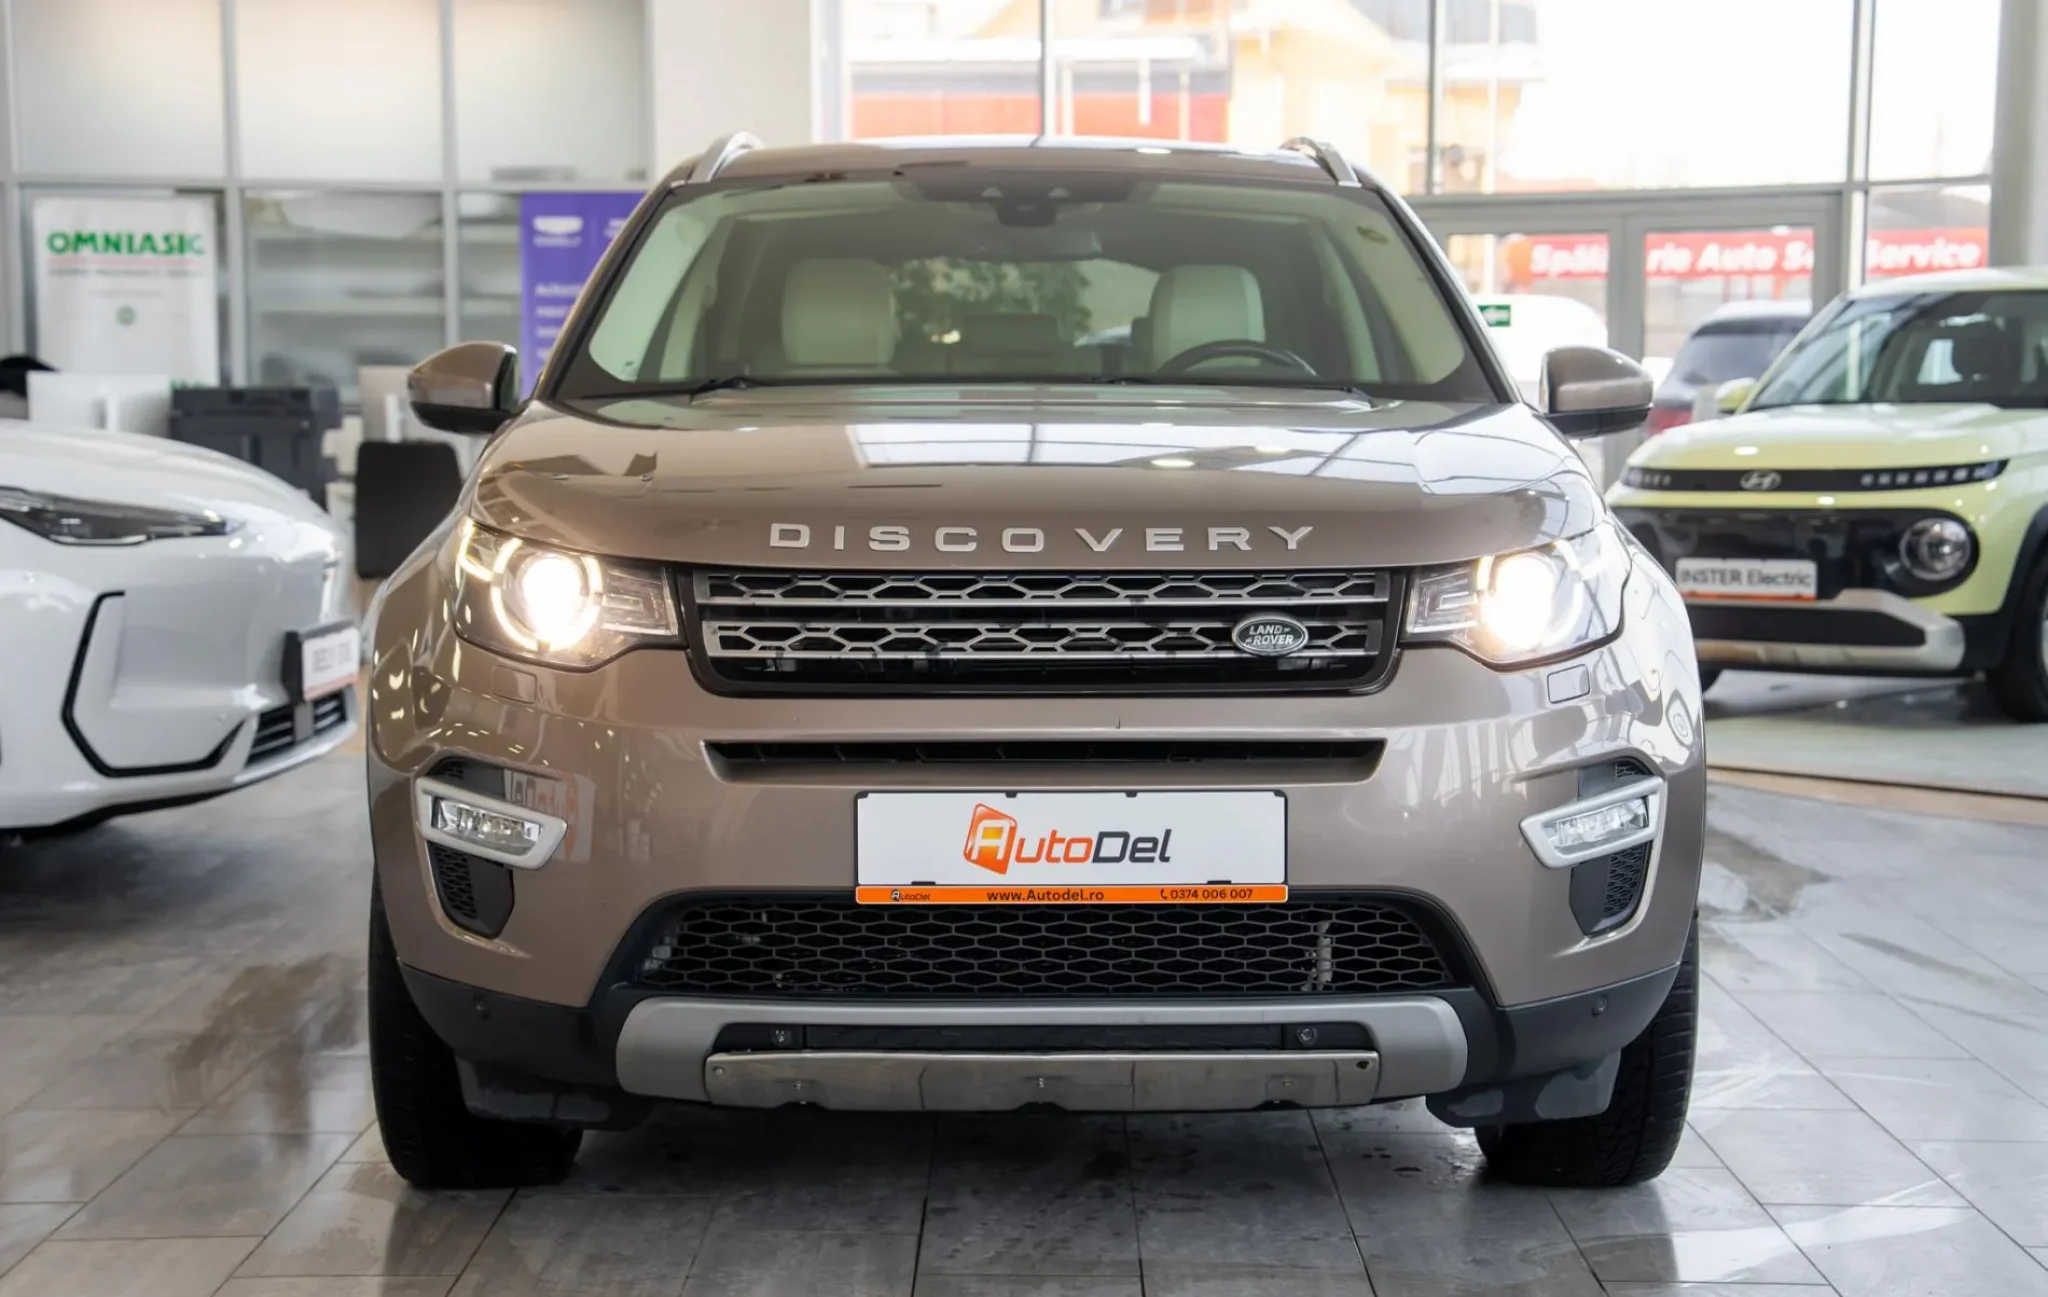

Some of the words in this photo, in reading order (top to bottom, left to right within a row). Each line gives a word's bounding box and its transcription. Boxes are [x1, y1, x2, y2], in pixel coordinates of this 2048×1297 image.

[1696, 243, 1776, 272] Auto
[769, 522, 1313, 553] DISCOVERY
[1679, 568, 1742, 587] INSTER
[1747, 569, 1812, 587] Electric
[1249, 625, 1282, 635] LAND
[1252, 634, 1294, 645] ROVER
[967, 813, 1172, 867] AutoDel
[987, 889, 1104, 901] www.Autodel.ro
[1170, 889, 1198, 900] 0374
[1202, 889, 1226, 900] 006
[1230, 889, 1253, 900] 007
